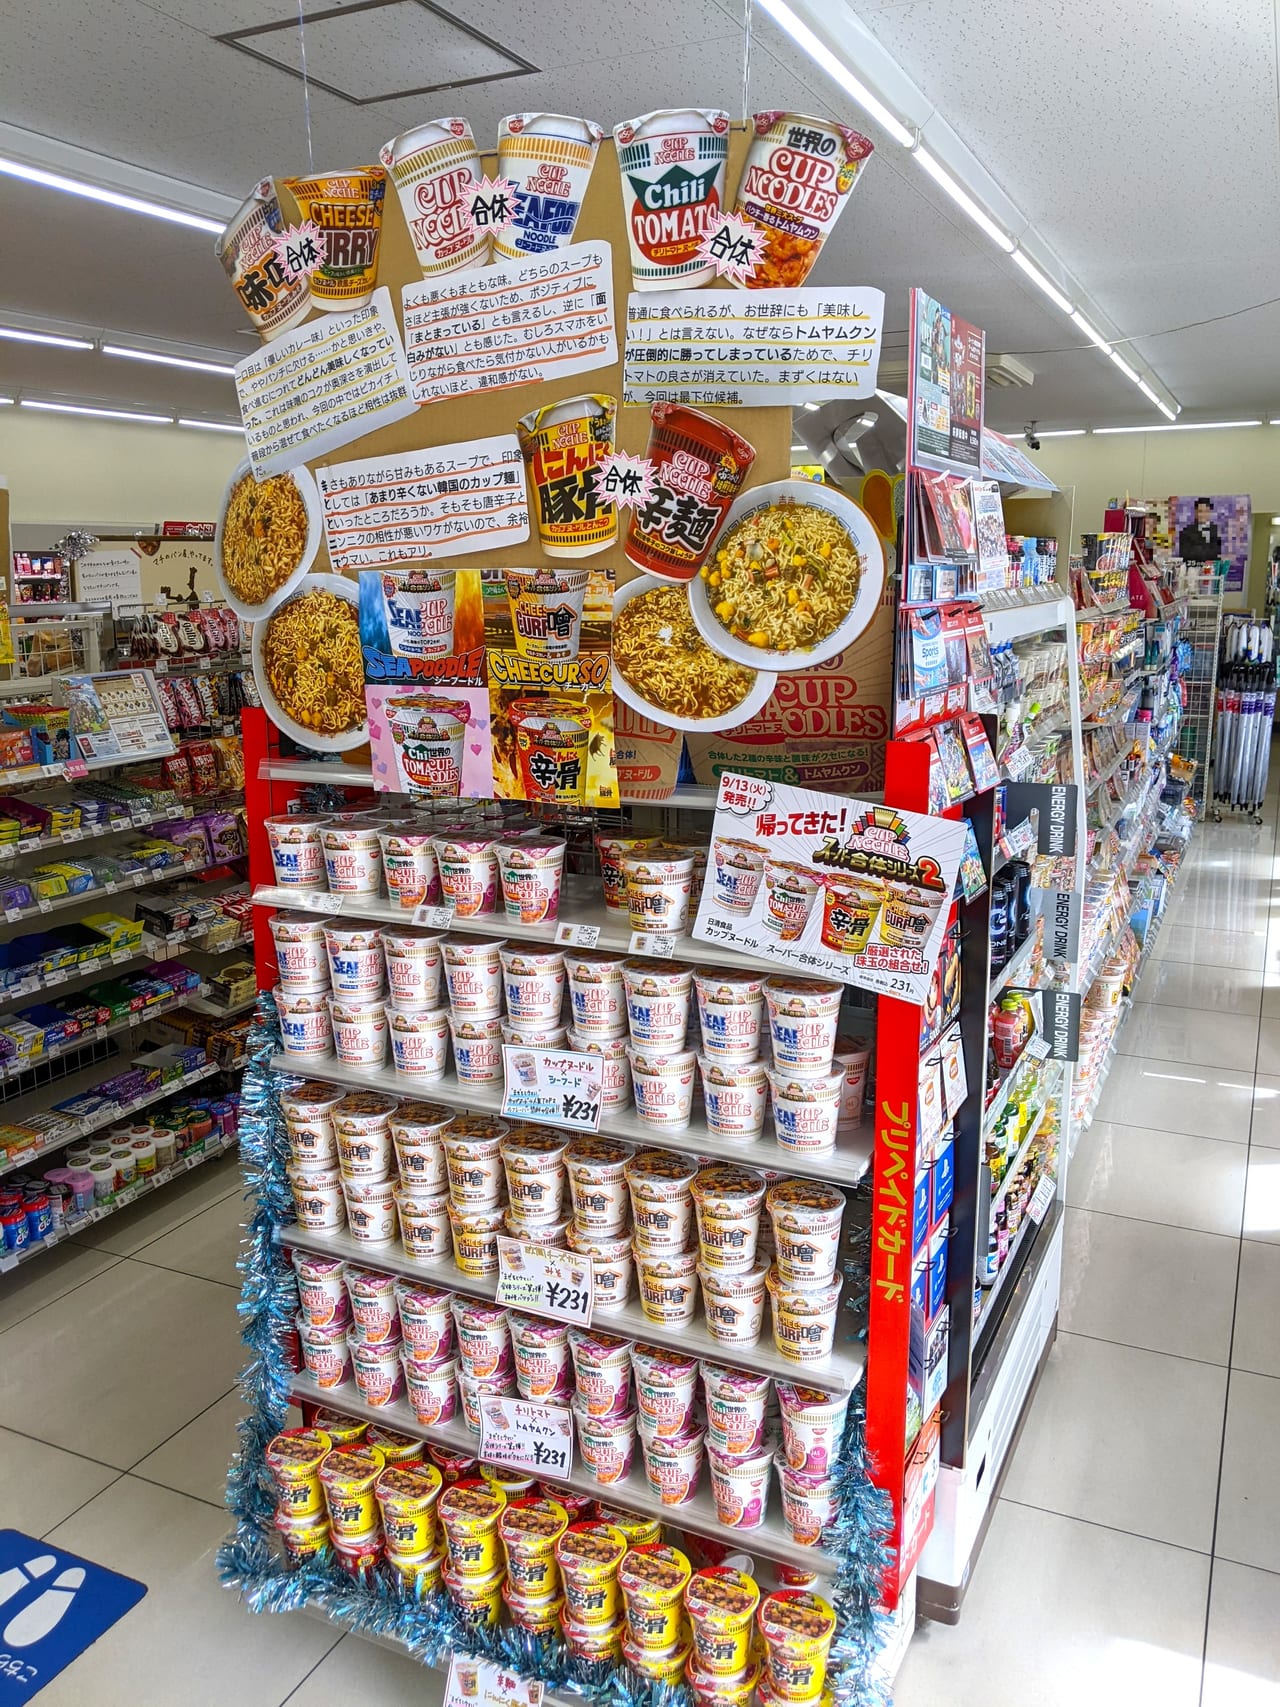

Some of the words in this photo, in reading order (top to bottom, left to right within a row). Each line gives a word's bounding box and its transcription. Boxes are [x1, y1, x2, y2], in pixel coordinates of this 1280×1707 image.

[660, 137, 689, 151] CUP
[787, 126, 836, 157] 世界の
[537, 163, 568, 180] CUP
[769, 147, 835, 186] CUP
[414, 167, 473, 215] CUP
[644, 178, 706, 207] Chili
[744, 167, 839, 222] NOODLES
[310, 201, 376, 227] CHEESE
[471, 193, 513, 226] 合体
[506, 180, 580, 235] EAFOO
[409, 208, 472, 250] NOO
[523, 229, 557, 245] NOODLE
[286, 237, 321, 273] 合体
[317, 229, 380, 268] URRY
[710, 225, 756, 266] 合体
[403, 254, 603, 310] よくも悪くもまともな味。どちらのスープも
[404, 275, 595, 328] さほど主張が強くないため、ポジティブに
[406, 313, 608, 364] 白みがない」とも感じた。むしろスマホをい
[409, 332, 610, 383] じりながら食べたら気付かない人がいるかも
[624, 347, 873, 363] が圧倒的に勝ってしまっているためで、チリ
[412, 366, 544, 401] しれないほど、違和感がない。
[624, 369, 859, 384] トマトの良さが消えていた。まずくはない
[623, 390, 744, 405] が、今回は最下位候補。
[557, 423, 581, 438] CUP
[672, 449, 711, 477] CUP
[603, 465, 643, 497] 合体
[659, 461, 713, 501] NOODLE
[362, 648, 485, 681] SEAPOODLE
[489, 652, 611, 685] CHEECURSO
[779, 678, 856, 707] CUP
[722, 776, 768, 797] 9/13(火)
[785, 766, 799, 782] &
[804, 764, 861, 778] トムヤムクン
[722, 790, 757, 809] 発売!!
[1051, 786, 1066, 825] ENERGY
[756, 808, 848, 838] 帰ってきた!
[863, 825, 898, 842] CUP
[1050, 826, 1065, 854] DRINK
[917, 855, 945, 886] 2
[707, 917, 733, 931] 日清食品
[1055, 892, 1071, 930] ENERGY
[705, 927, 759, 948] カップヌードル
[766, 944, 851, 976] スーパー合体シリーズ
[867, 945, 922, 960] 厳選された
[1053, 932, 1070, 959] DRINK
[855, 955, 929, 973] 珠玉の組合せ!
[1055, 993, 1071, 1030] ENERGY
[1053, 1032, 1070, 1059] DRINK
[543, 1057, 594, 1072] カップヌードル
[548, 1075, 582, 1088] シーフード
[562, 1094, 599, 1123] ¥231
[876, 1100, 910, 1304] プリペイドカード
[545, 1281, 589, 1314] ¥231
[514, 1404, 551, 1419] チリトマト
[516, 1420, 556, 1437] トムヤムクン
[533, 1441, 567, 1468] ¥231
